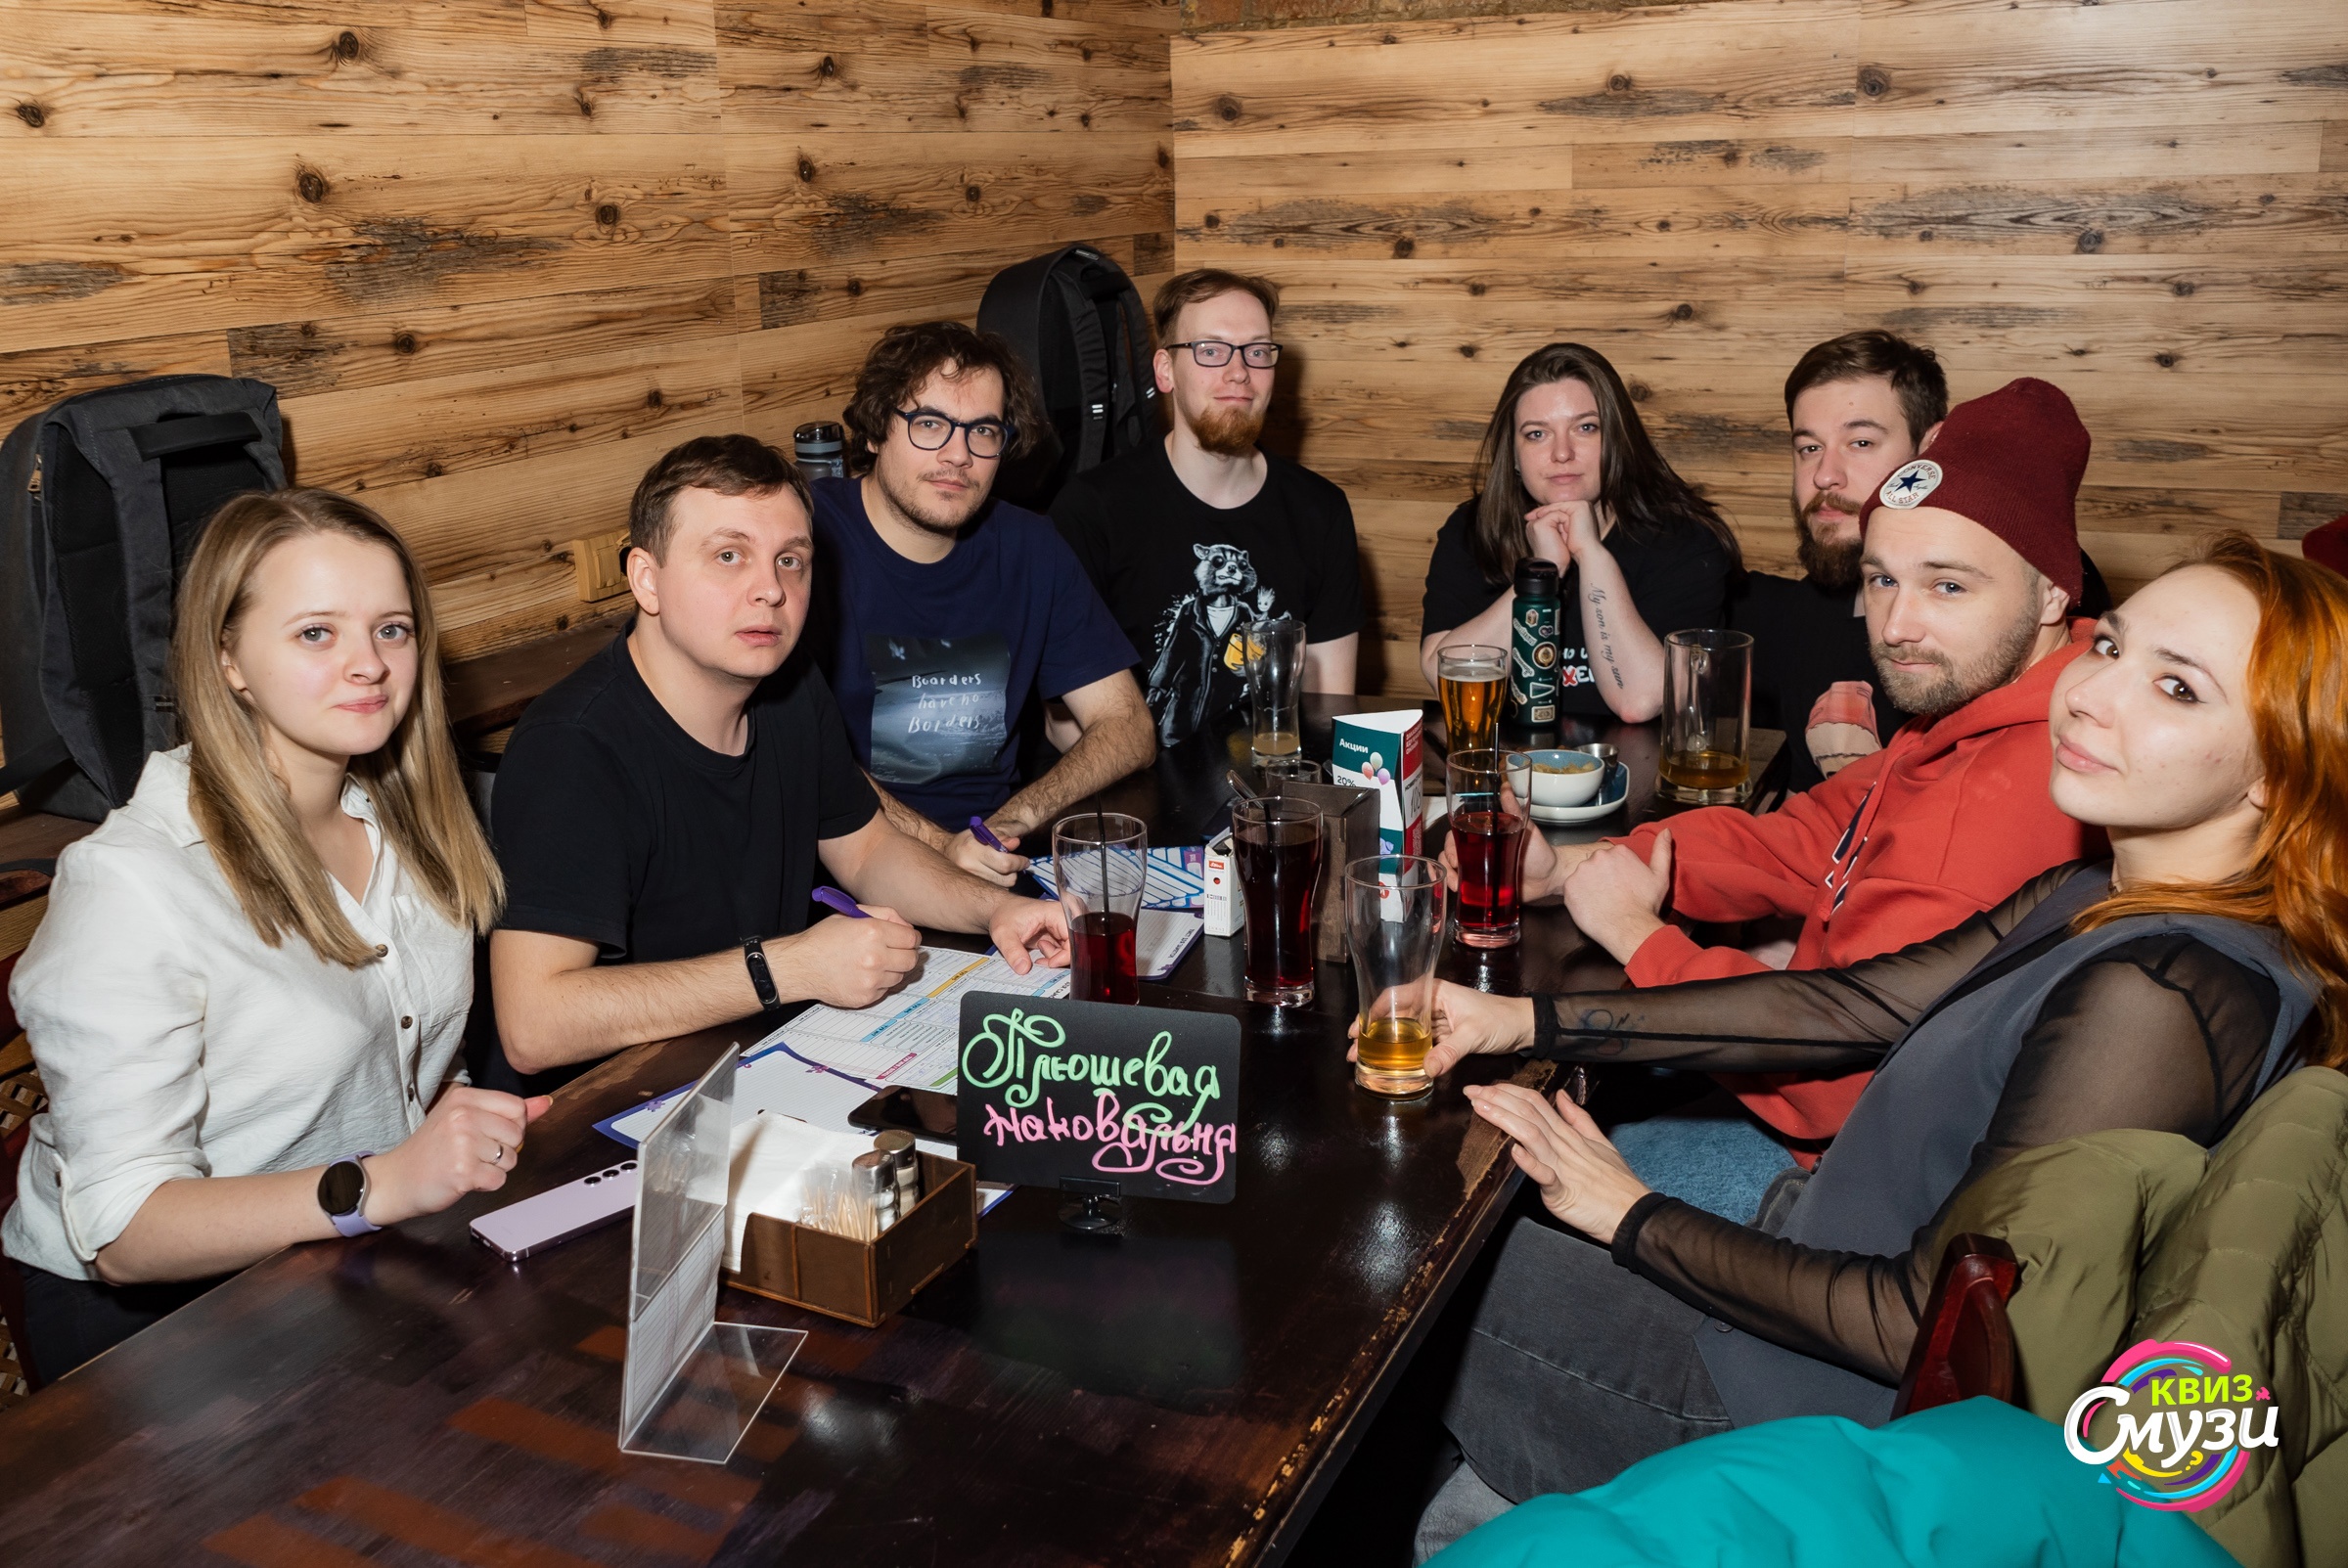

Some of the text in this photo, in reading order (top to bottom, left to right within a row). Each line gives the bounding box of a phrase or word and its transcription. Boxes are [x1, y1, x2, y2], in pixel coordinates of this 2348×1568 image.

[1897, 464, 1936, 480] CONVERSE
[1885, 490, 1919, 505] ALL STAR
[1588, 583, 1624, 690] My son is my sun
[912, 673, 982, 688] Boarders
[918, 693, 978, 709] have no
[908, 715, 980, 734] Borders
[1339, 738, 1369, 754] Акции
[962, 1008, 1220, 1138] Плюшевая
[983, 1088, 1237, 1185] Наковальня
